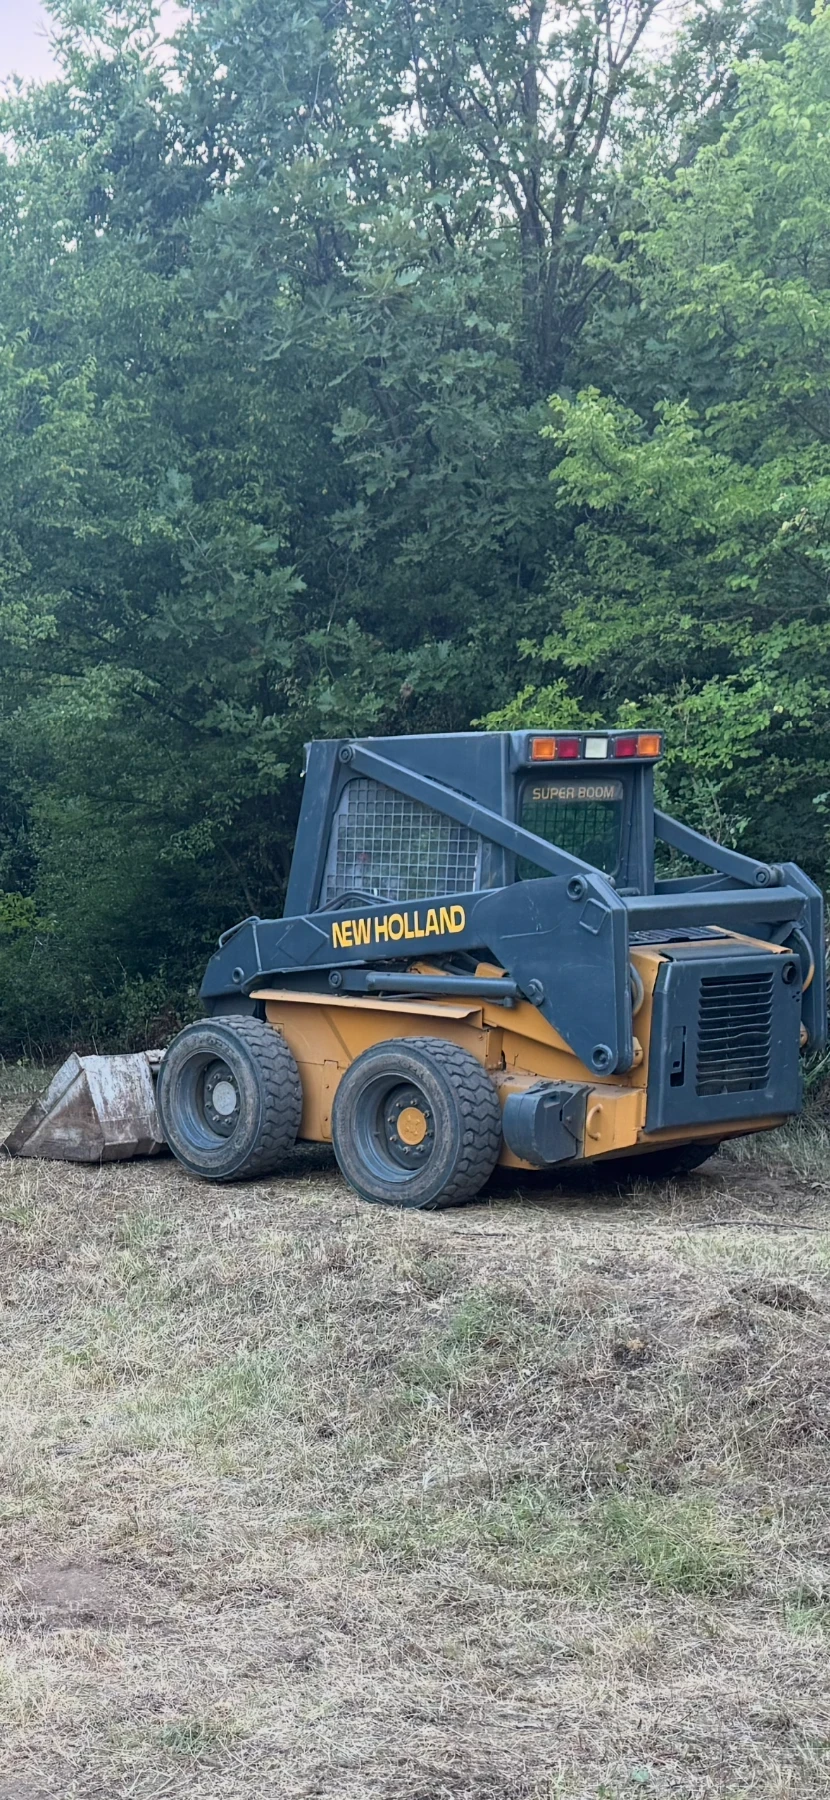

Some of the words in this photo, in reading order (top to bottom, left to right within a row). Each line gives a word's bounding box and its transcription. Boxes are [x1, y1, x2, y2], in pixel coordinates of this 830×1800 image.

[532, 787, 575, 800] SUPER
[578, 786, 614, 799] BOOM
[332, 917, 371, 948] NEW
[375, 905, 465, 942] HOLLAND
